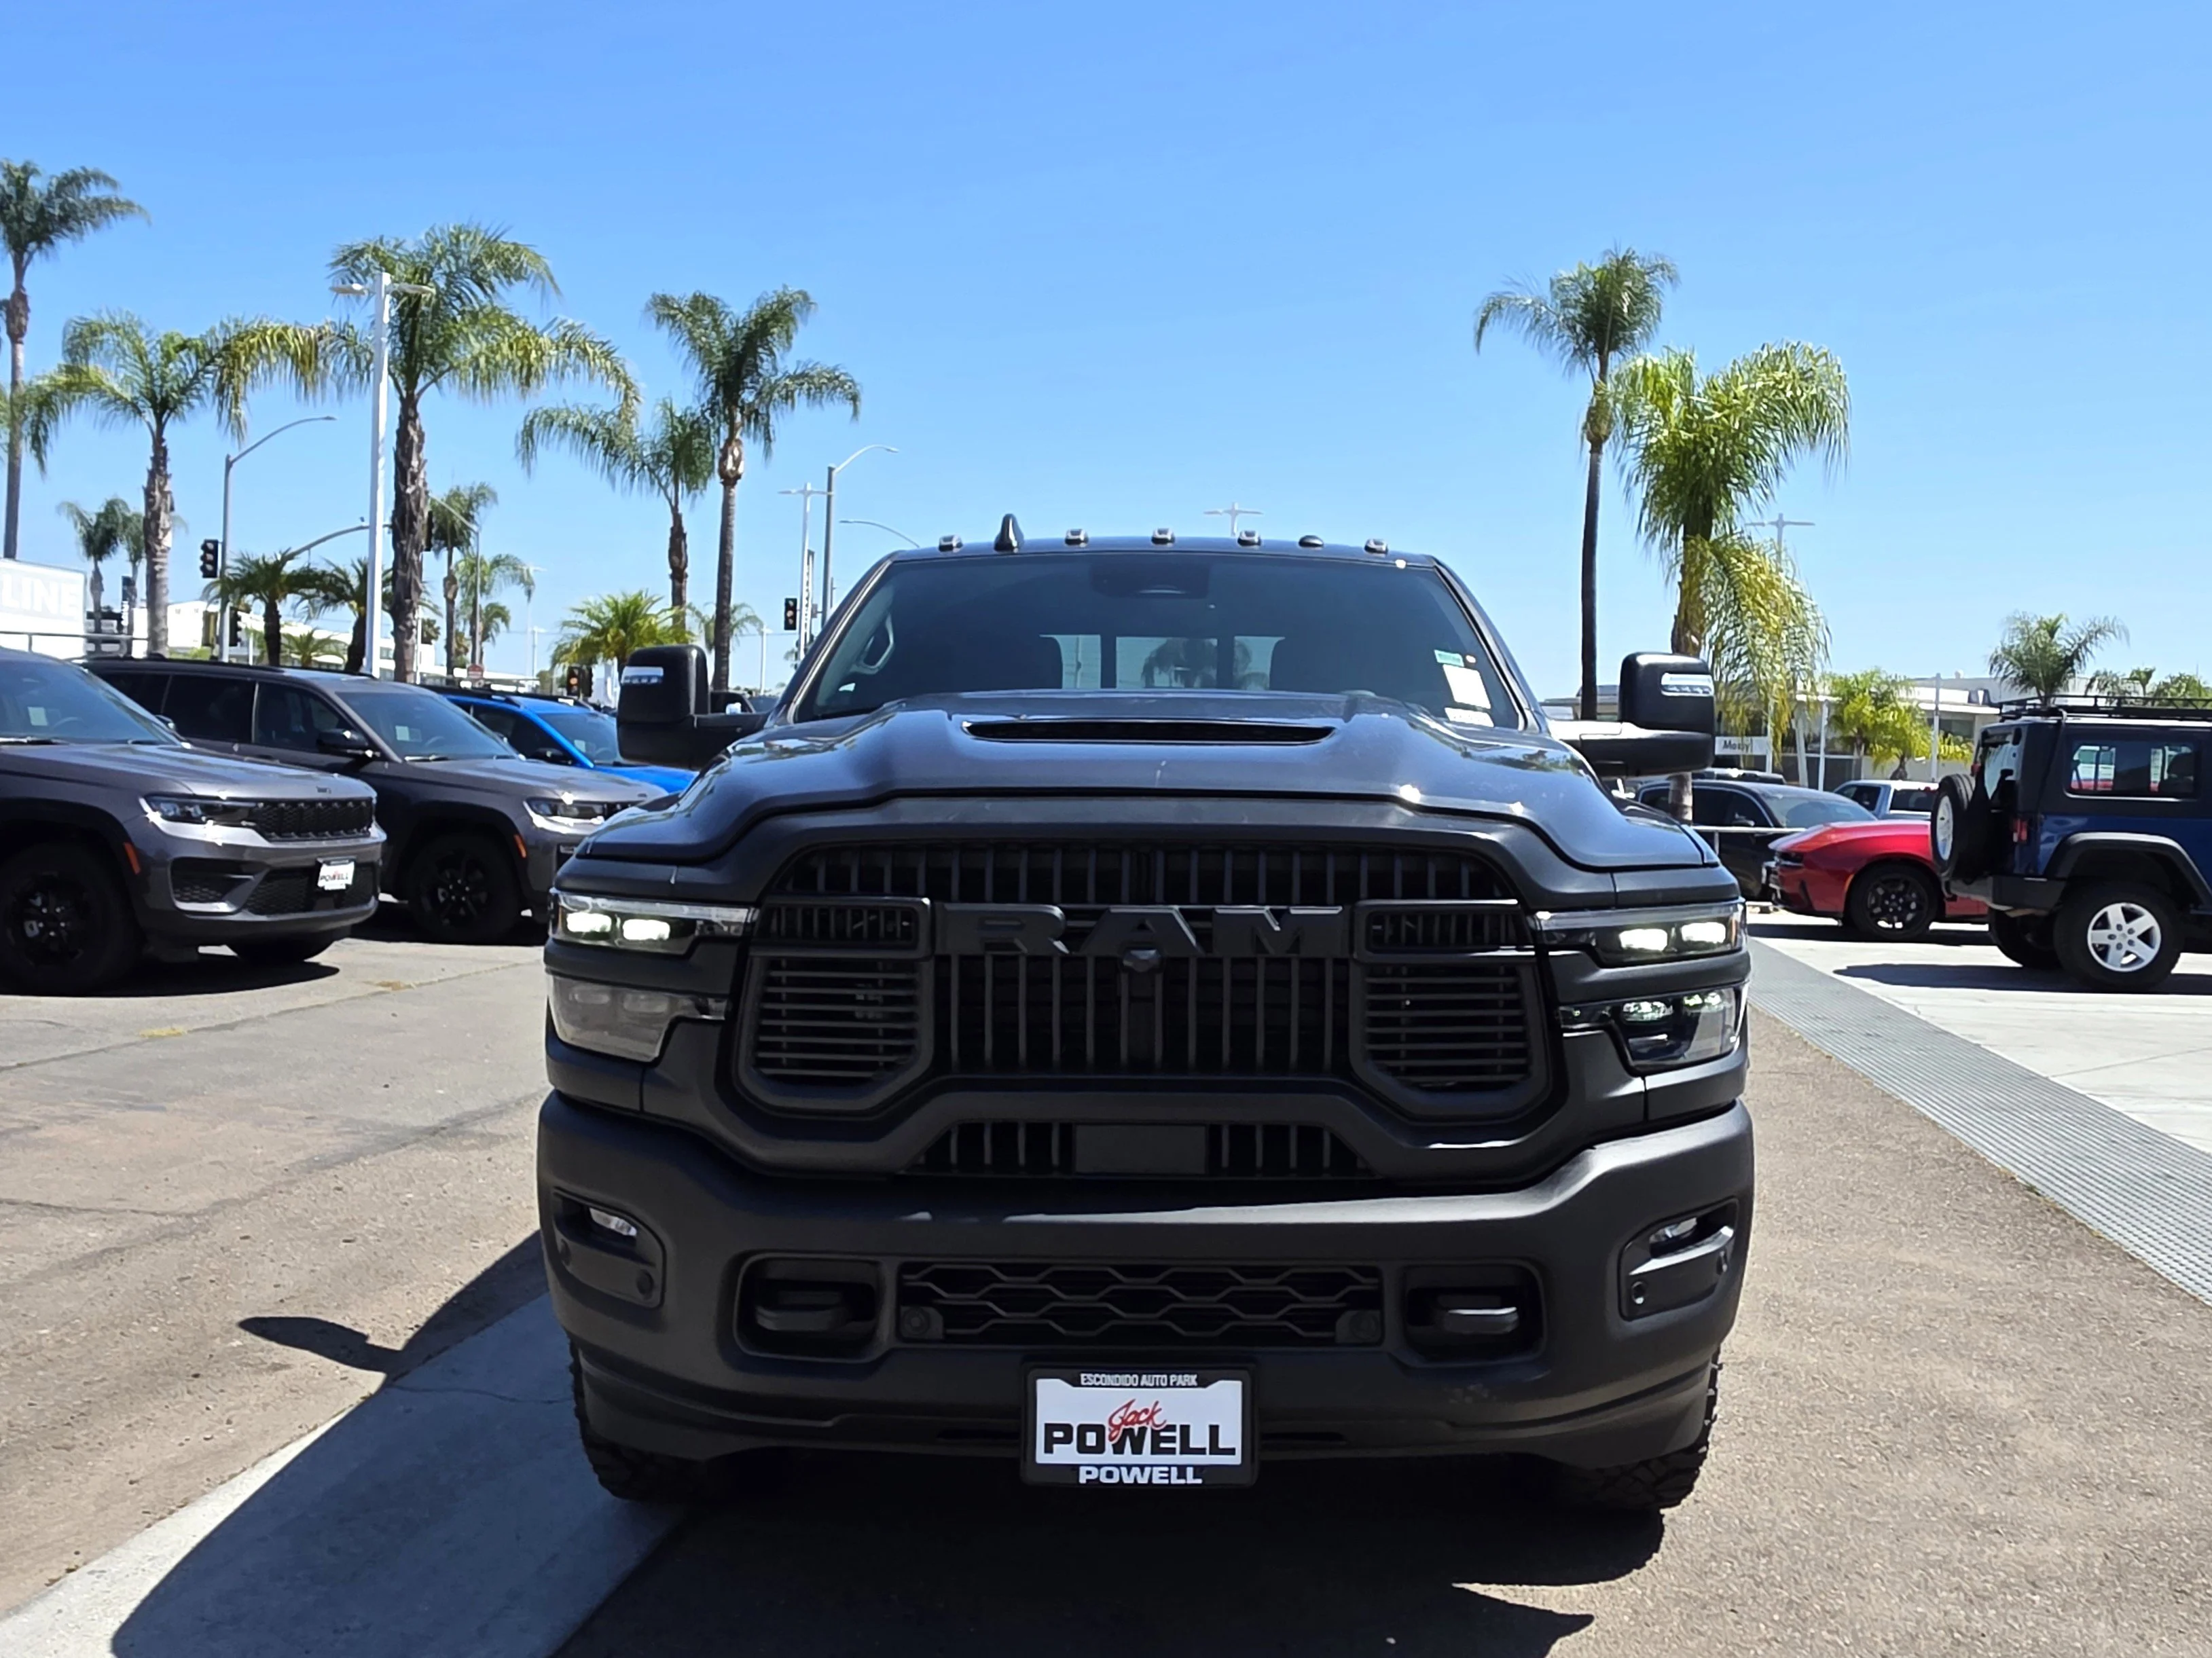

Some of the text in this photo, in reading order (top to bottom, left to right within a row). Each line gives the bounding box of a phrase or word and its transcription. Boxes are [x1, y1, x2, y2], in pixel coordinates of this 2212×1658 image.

[2, 573, 80, 617] LINE
[942, 904, 1344, 954] RAM
[1081, 1373, 1198, 1386] ESCONDIDO AUTO PARK
[1044, 1423, 1236, 1456] POWELL
[1108, 1398, 1167, 1443] Jack
[1078, 1466, 1203, 1484] POWELL
